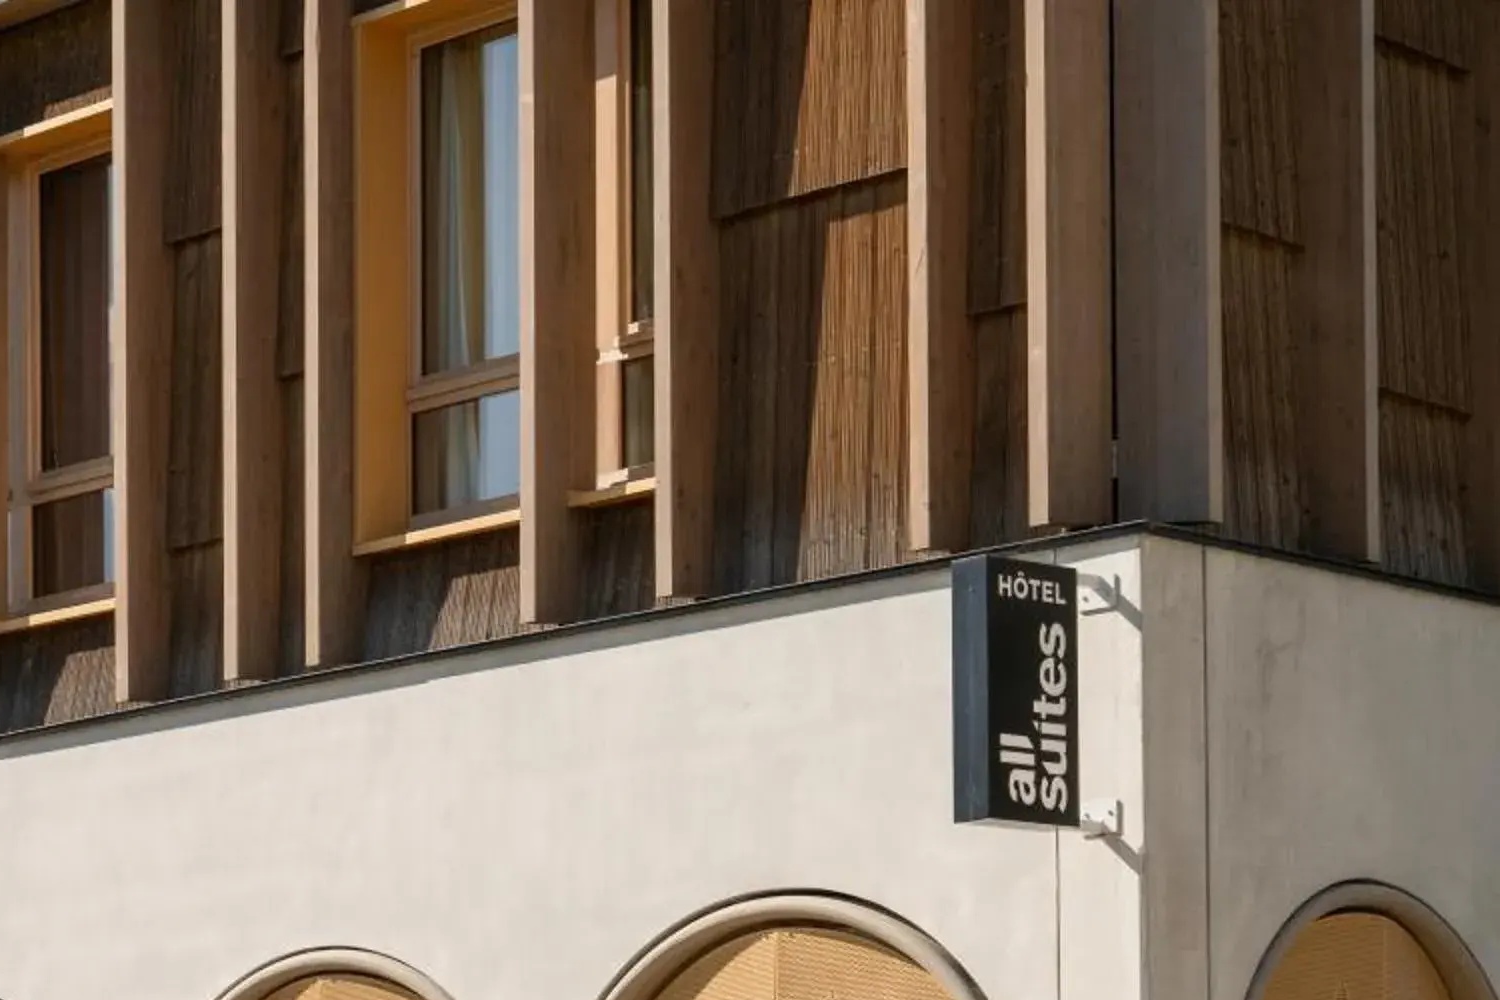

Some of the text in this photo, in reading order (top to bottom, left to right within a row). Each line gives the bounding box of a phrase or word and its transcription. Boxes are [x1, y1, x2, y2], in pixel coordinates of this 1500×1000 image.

[998, 571, 1066, 604] HÔTEL
[1033, 622, 1067, 812] suites
[1000, 733, 1036, 804] all
